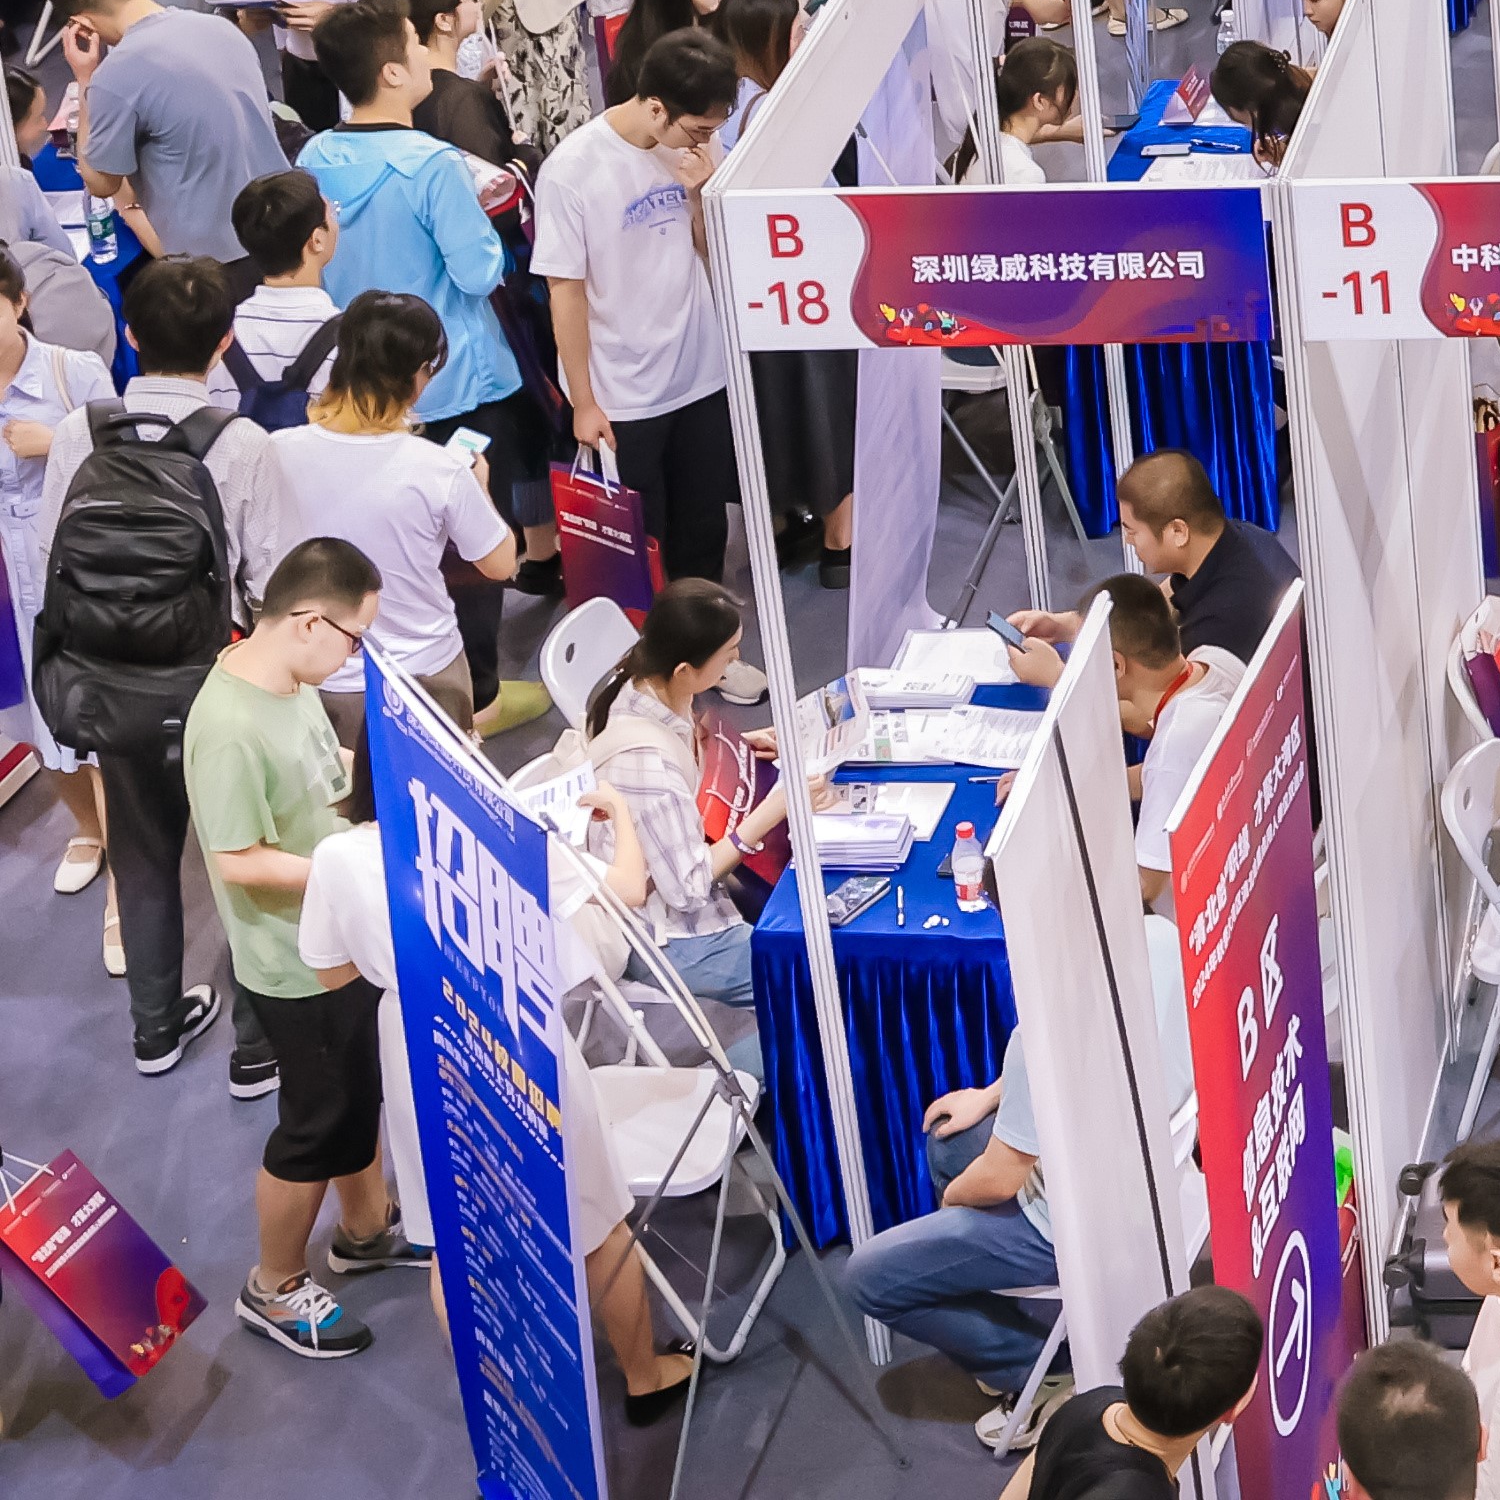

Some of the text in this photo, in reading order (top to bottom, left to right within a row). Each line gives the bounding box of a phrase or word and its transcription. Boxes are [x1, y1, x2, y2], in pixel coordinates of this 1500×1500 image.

[767, 213, 804, 259] B
[1340, 203, 1376, 248] B
[911, 251, 1205, 284] 深圳绿威科技有限公司
[748, 281, 830, 325] -18
[1323, 270, 1392, 315] -11
[407, 777, 556, 1055] 招聘
[1236, 913, 1286, 1083] B区
[1242, 1014, 1304, 1213] 信息技术
[1252, 1083, 1308, 1279] &互联网
